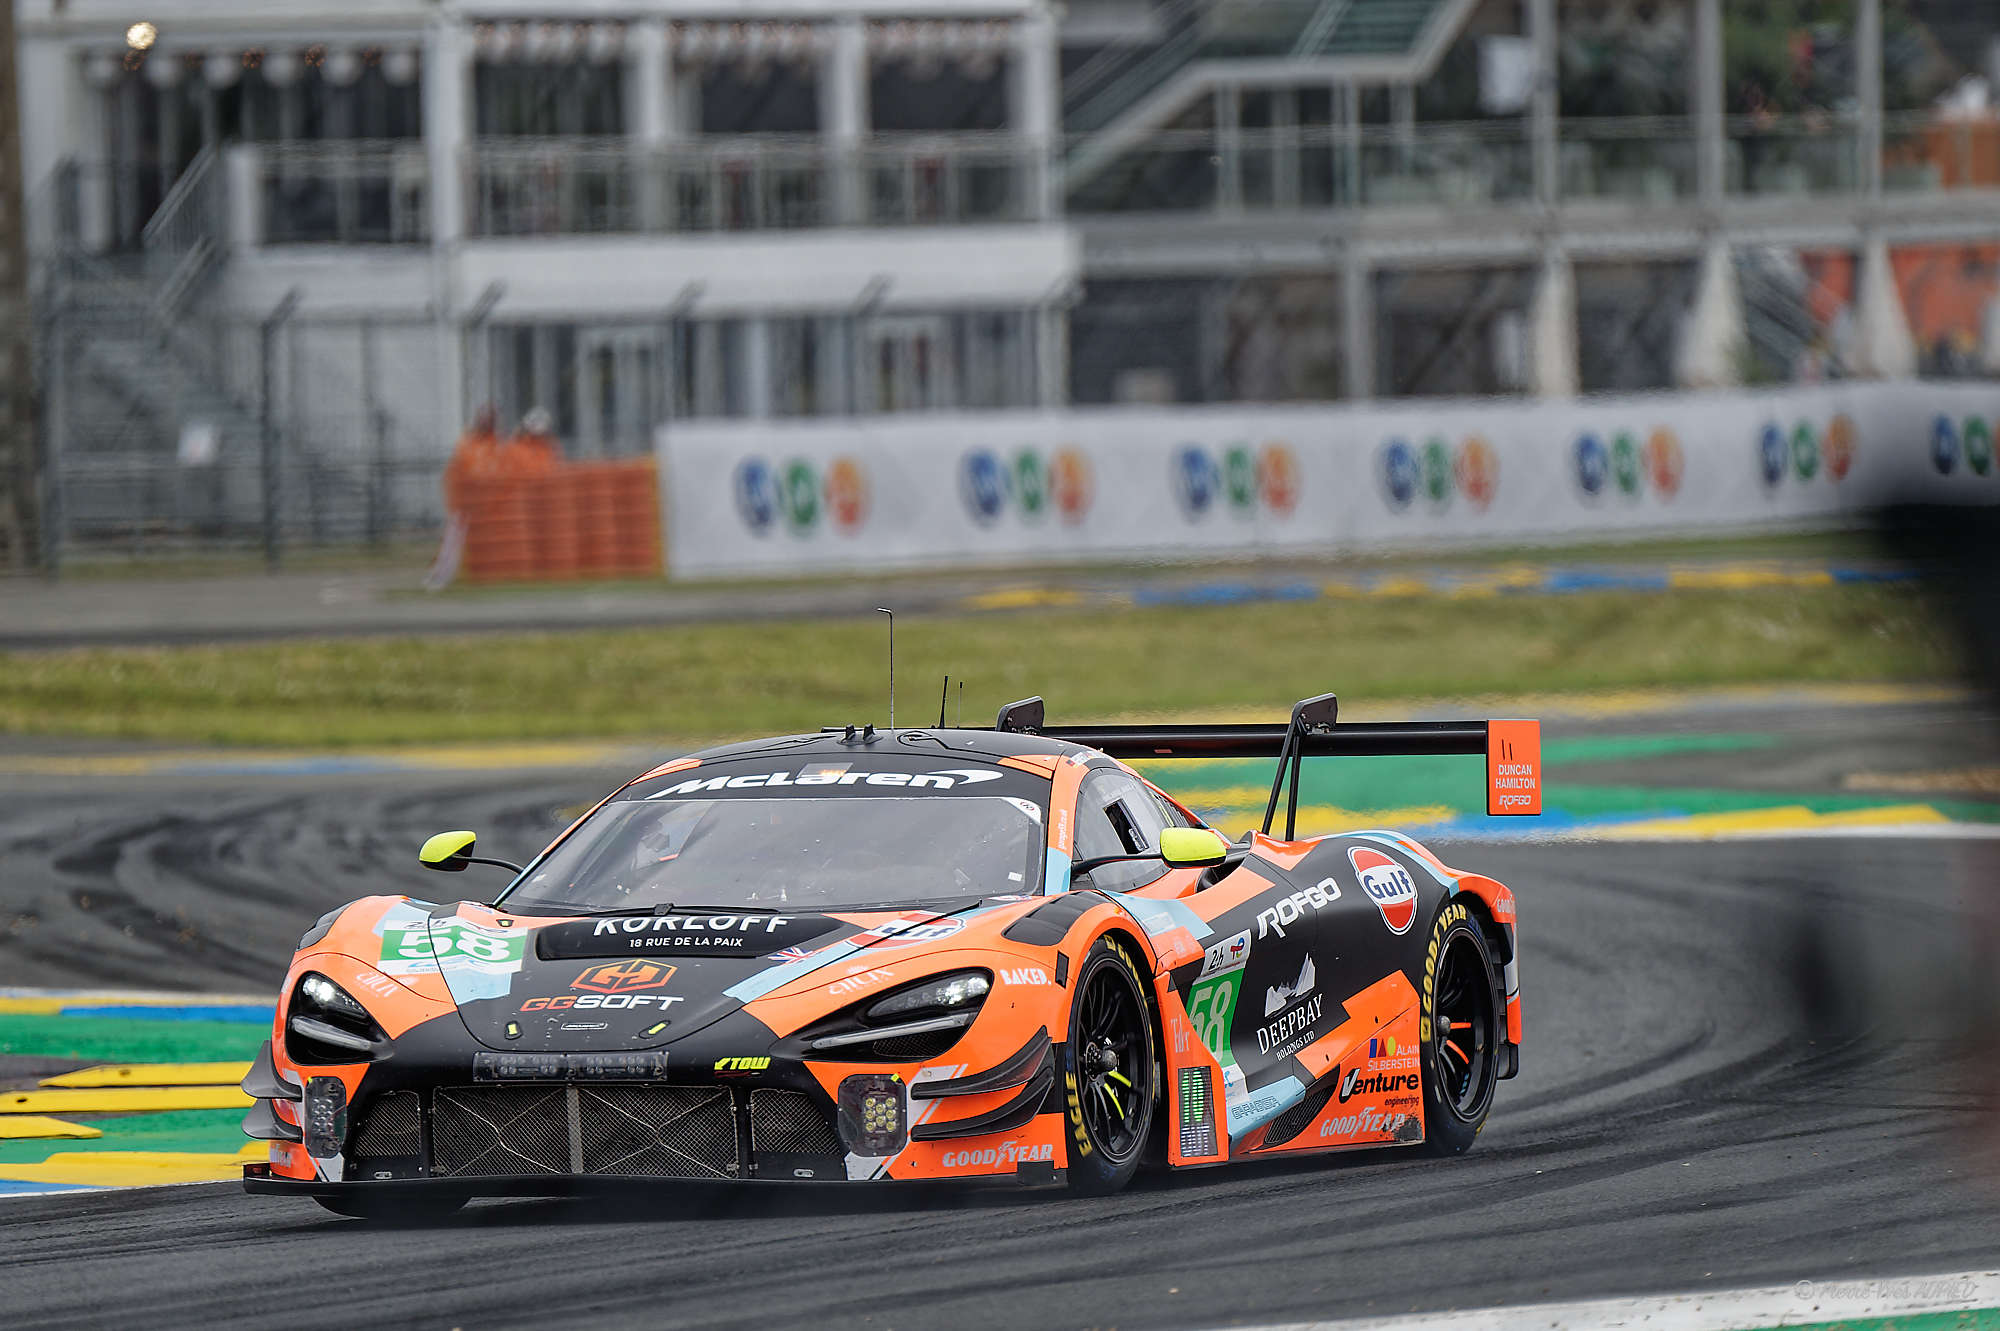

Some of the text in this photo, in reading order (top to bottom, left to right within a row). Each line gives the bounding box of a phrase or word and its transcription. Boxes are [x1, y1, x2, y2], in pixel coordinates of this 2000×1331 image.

[1498, 764, 1532, 775] DUNCAN
[1495, 778, 1535, 789] HAMILTON
[1363, 871, 1412, 899] Gulf
[1256, 877, 1342, 940] ROFGO
[593, 916, 796, 936] KORLOFF
[398, 927, 511, 961] 58
[629, 937, 743, 948] 18 RUE DE LA PAIX
[520, 994, 684, 1012] GGSOFT
[1189, 980, 1233, 1062] 58
[1256, 993, 1323, 1055] DEEPBAY
[1276, 1030, 1315, 1061] HOLDINGS LTD
[1396, 1044, 1419, 1056] ALAIN
[730, 1056, 772, 1070] TOW
[1367, 1057, 1420, 1072] SILBERSTEIN
[1339, 1067, 1419, 1104] Venture
[1384, 1096, 1420, 1108] engineering
[1065, 1071, 1093, 1157] EAGLE
